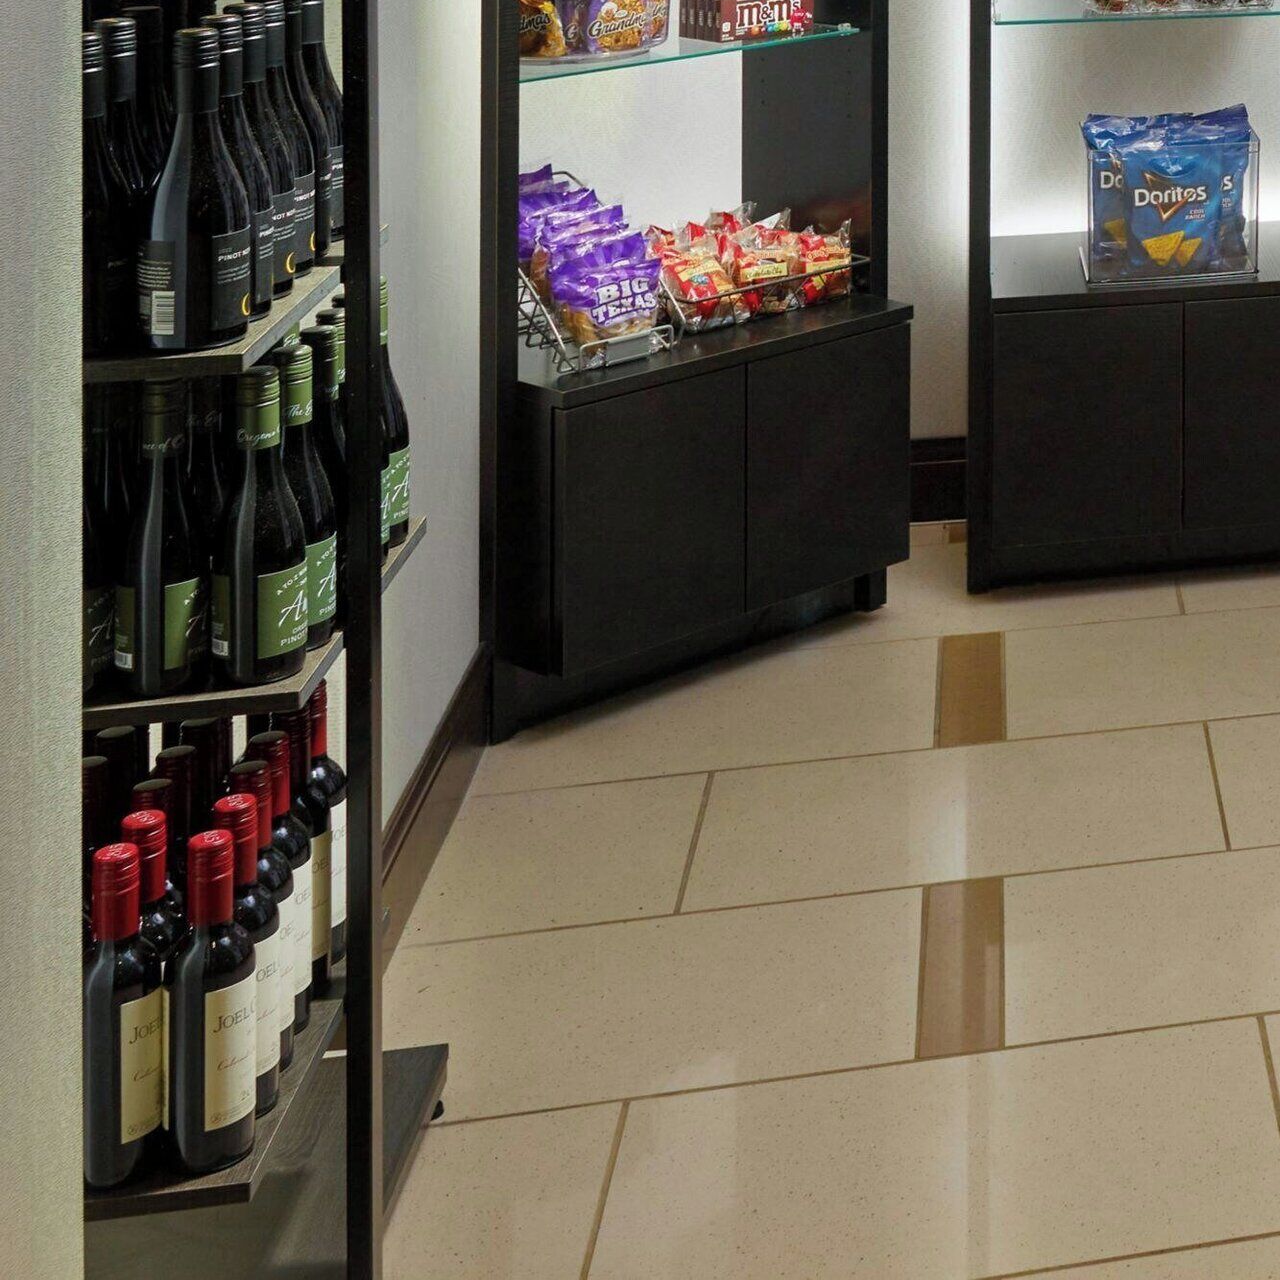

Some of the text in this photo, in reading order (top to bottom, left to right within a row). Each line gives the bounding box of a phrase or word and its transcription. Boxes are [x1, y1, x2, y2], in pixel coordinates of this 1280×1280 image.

[520, 11, 552, 31] dma's
[1134, 186, 1207, 207] Doritos
[596, 277, 650, 305] BIG
[591, 292, 657, 324] TEXAS
[256, 962, 279, 983] OEL
[213, 1006, 251, 1033] JOEL
